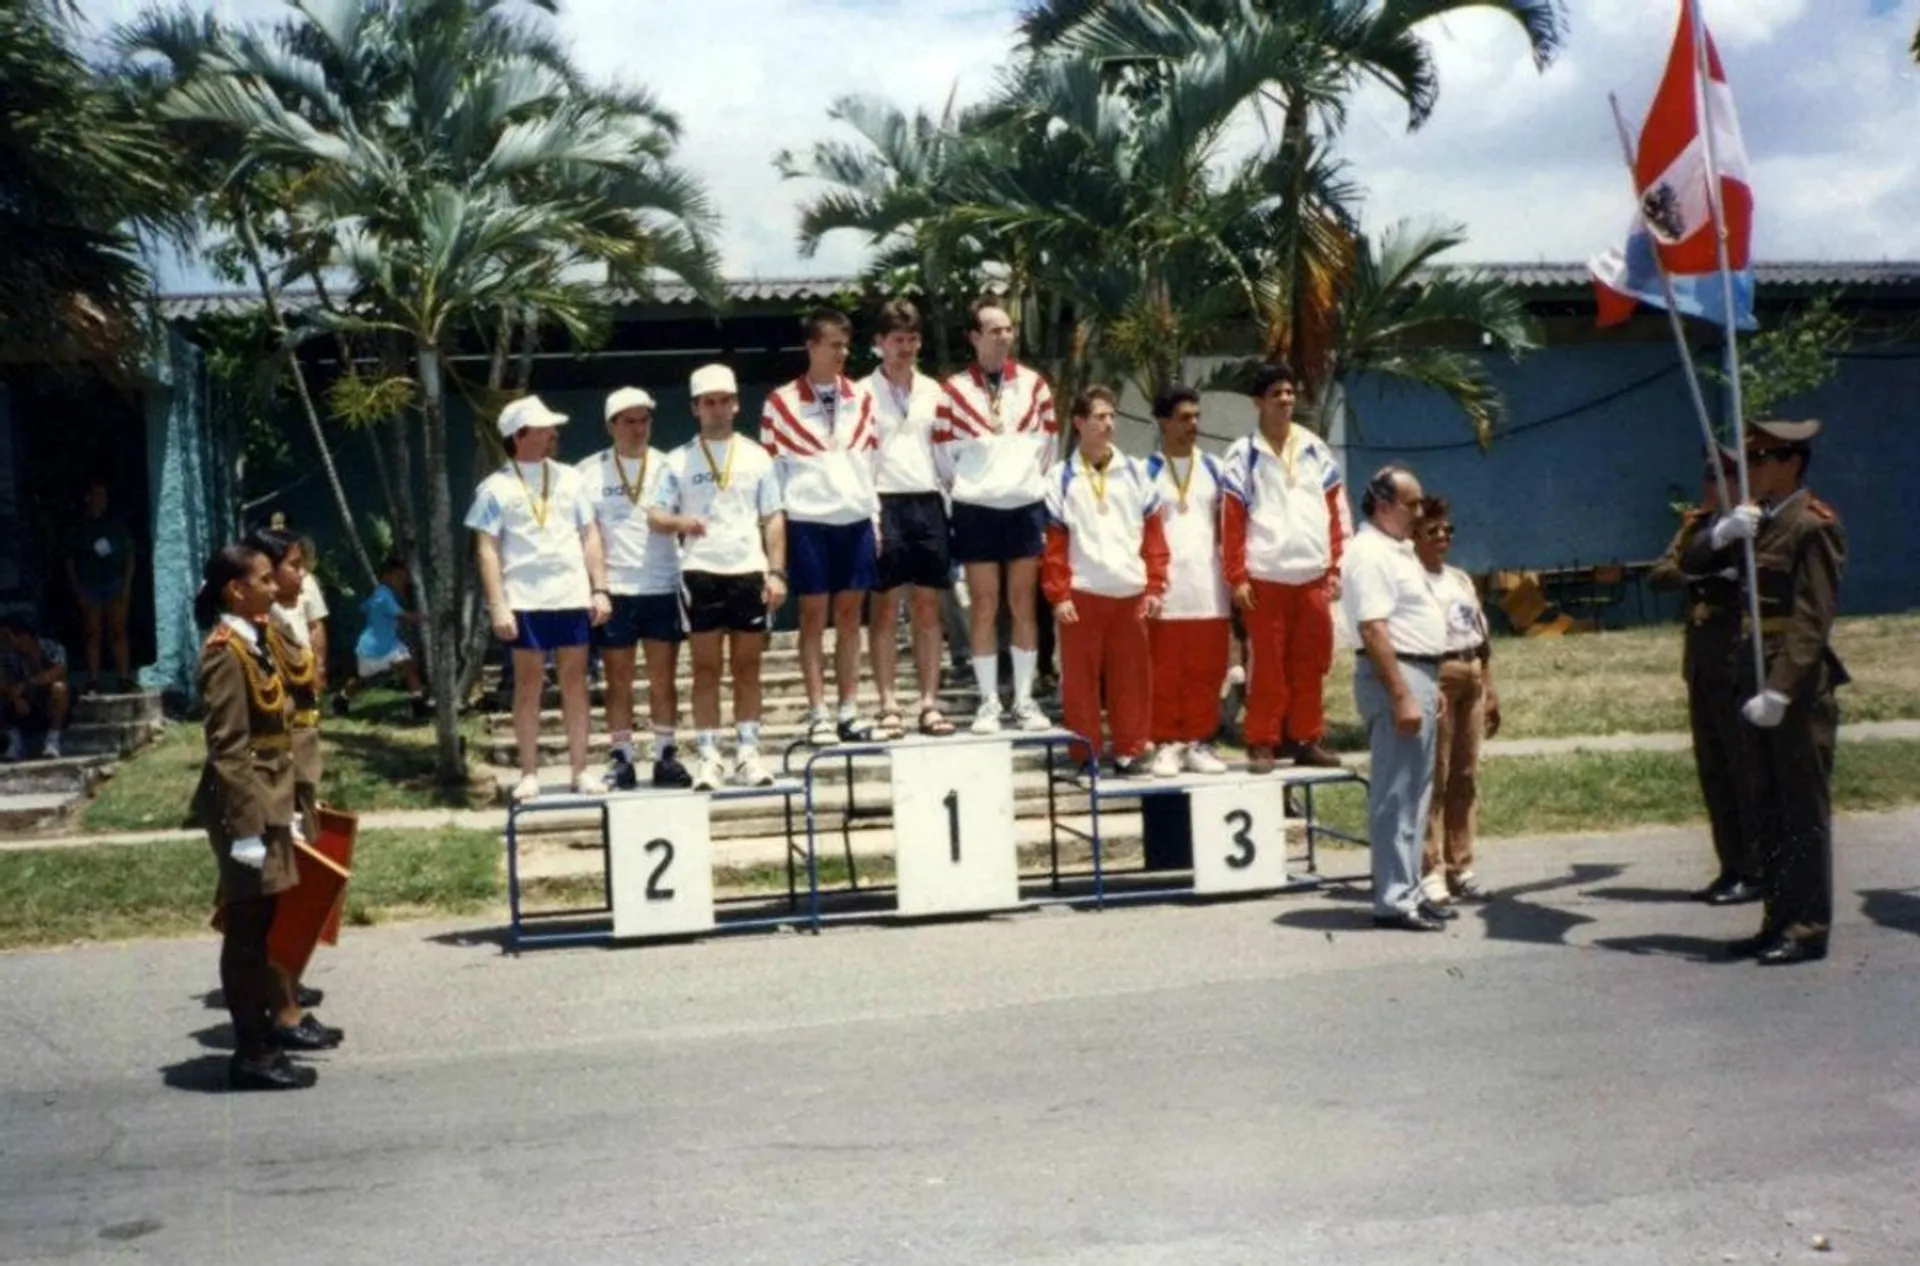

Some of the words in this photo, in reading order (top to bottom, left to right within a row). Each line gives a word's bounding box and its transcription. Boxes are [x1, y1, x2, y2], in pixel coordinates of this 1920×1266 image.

[943, 790, 960, 862] 1
[1224, 809, 1256, 869] 3
[644, 838, 675, 901] 2
